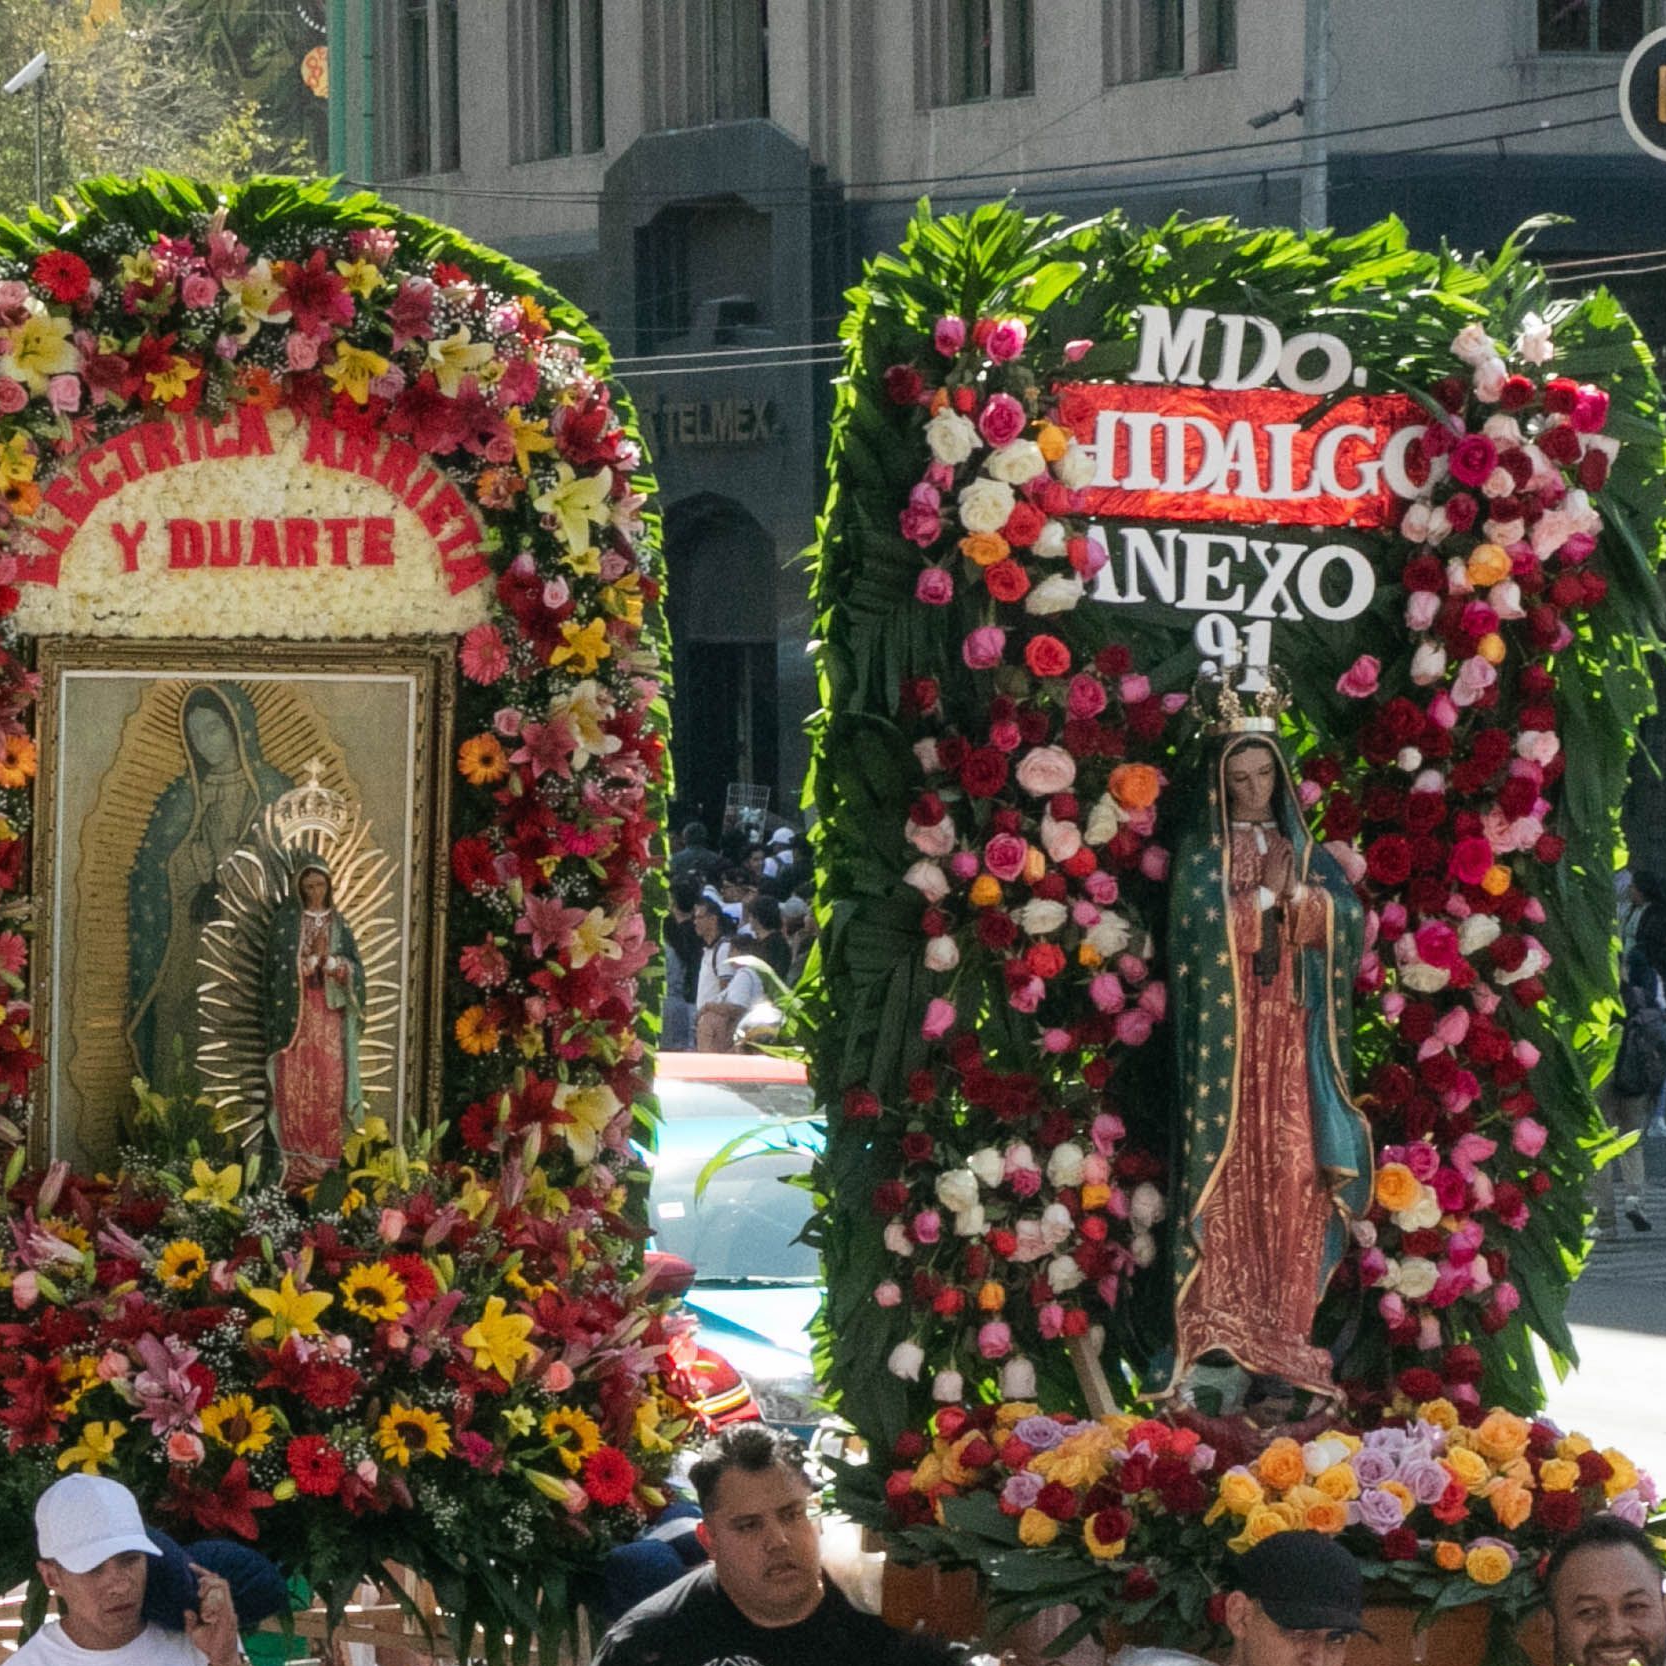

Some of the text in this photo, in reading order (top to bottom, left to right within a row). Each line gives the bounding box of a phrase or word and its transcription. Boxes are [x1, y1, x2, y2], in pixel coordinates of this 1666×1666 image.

[1129, 304, 1367, 395] MDO.
[111, 517, 396, 572] Y DUARTE
[302, 412, 491, 597] ARRIETA
[1088, 525, 1376, 622] ANEXO
[1194, 612, 1273, 692] 91
